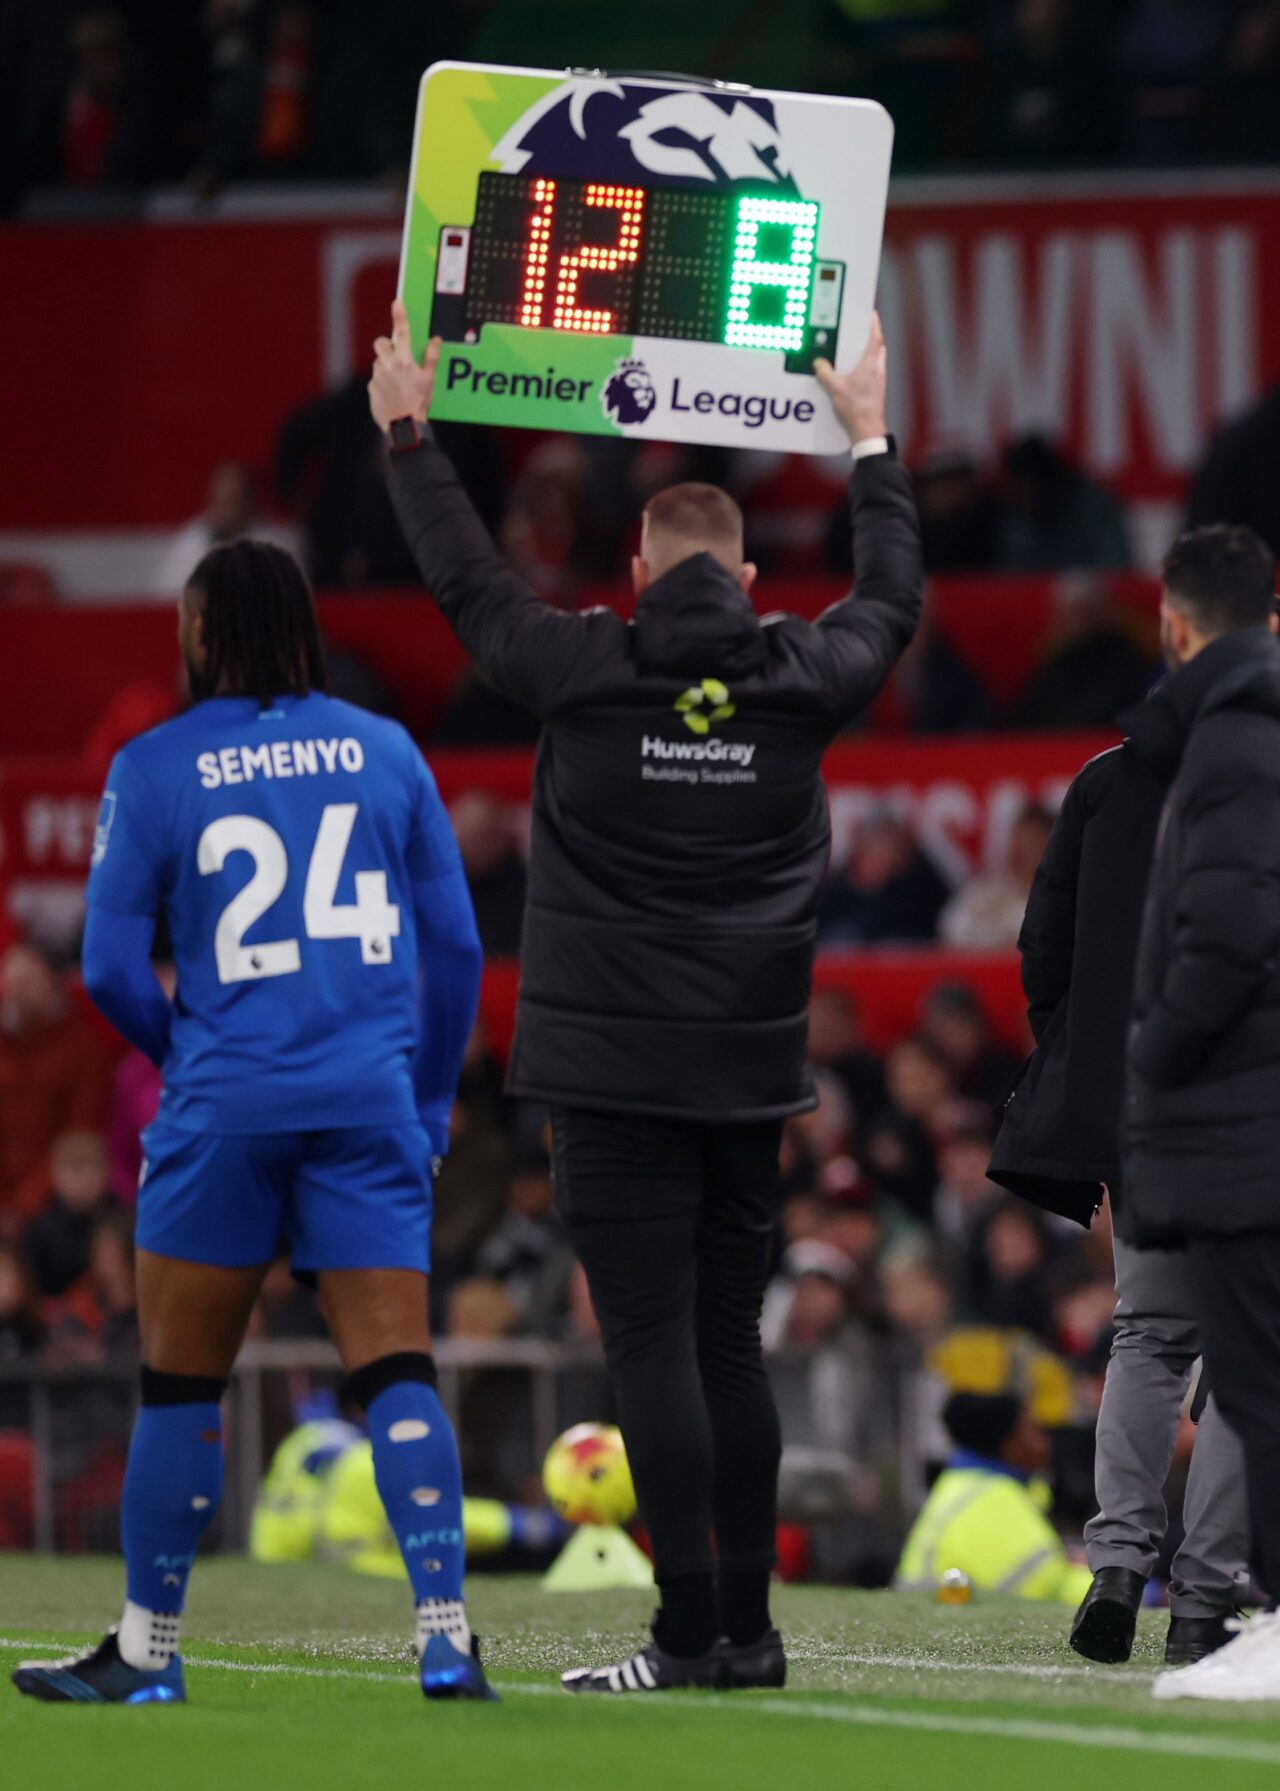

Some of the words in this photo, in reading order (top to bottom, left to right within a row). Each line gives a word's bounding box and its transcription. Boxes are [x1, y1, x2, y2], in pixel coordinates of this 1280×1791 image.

[520, 178, 646, 333] 12
[725, 196, 818, 352] 8
[446, 357, 593, 402] Premier
[671, 378, 816, 428] League
[197, 737, 365, 790] SEMENYO
[641, 735, 755, 766] HuwsGray
[641, 764, 699, 784] Building
[700, 768, 757, 784] Supplies
[196, 803, 400, 985] 24
